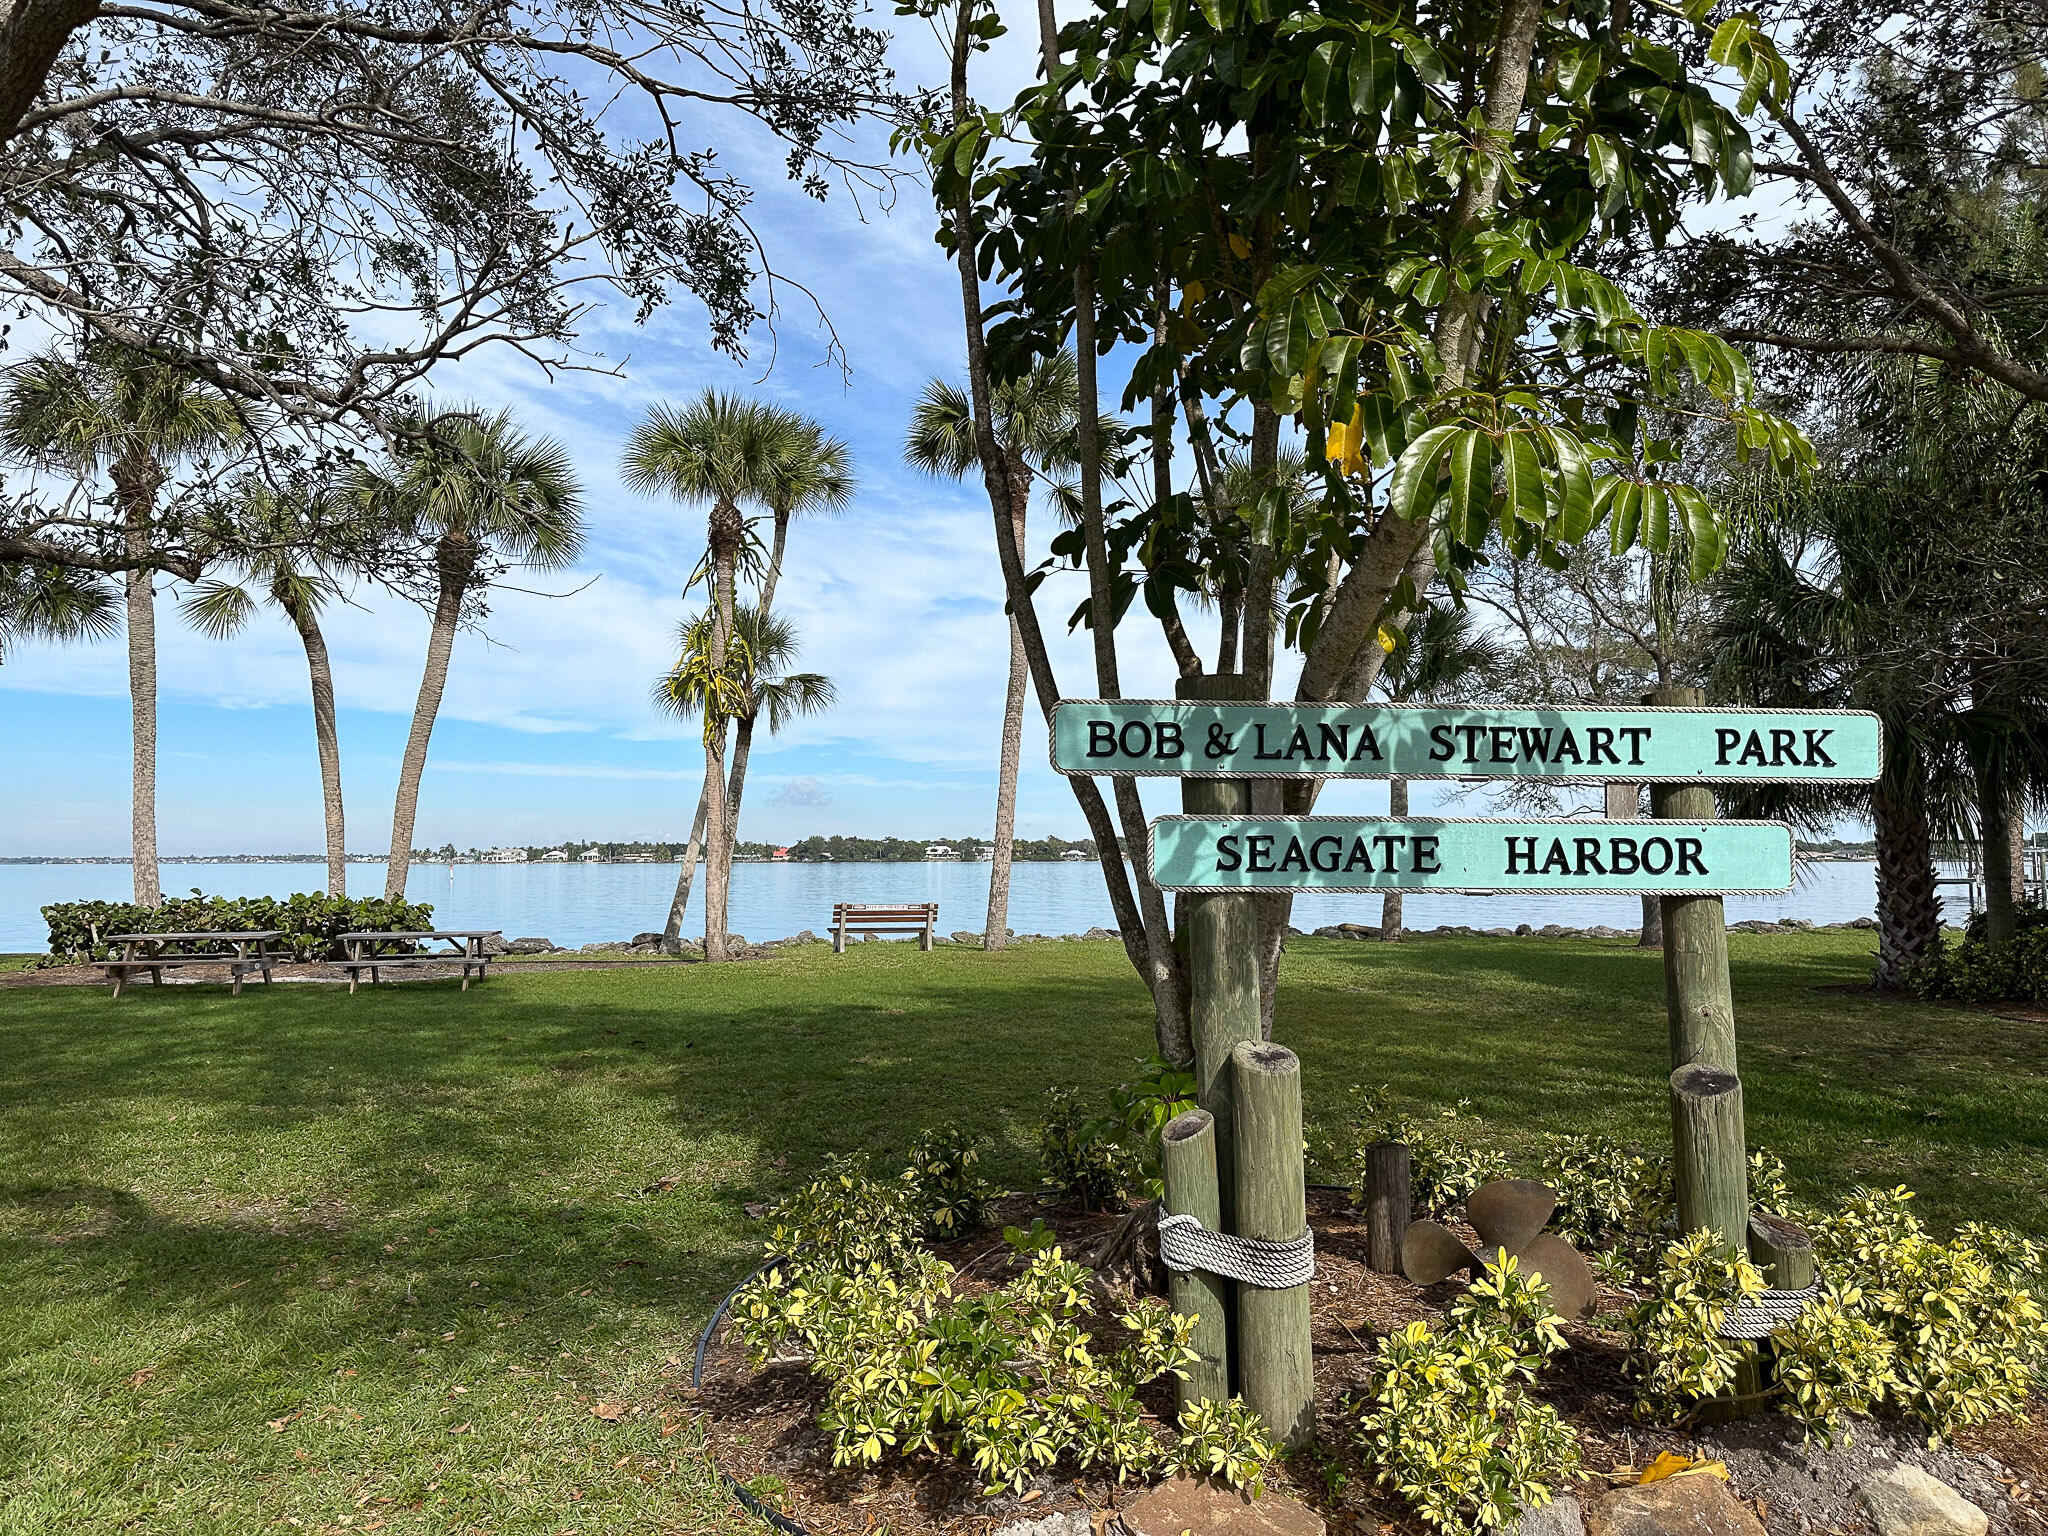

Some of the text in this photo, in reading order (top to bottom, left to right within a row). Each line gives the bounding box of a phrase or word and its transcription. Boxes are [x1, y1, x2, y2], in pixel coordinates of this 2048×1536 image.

[1086, 720, 1838, 767] BOB & LANA STEWART PARK
[1216, 834, 1709, 876] SEAGATE HARBOR
